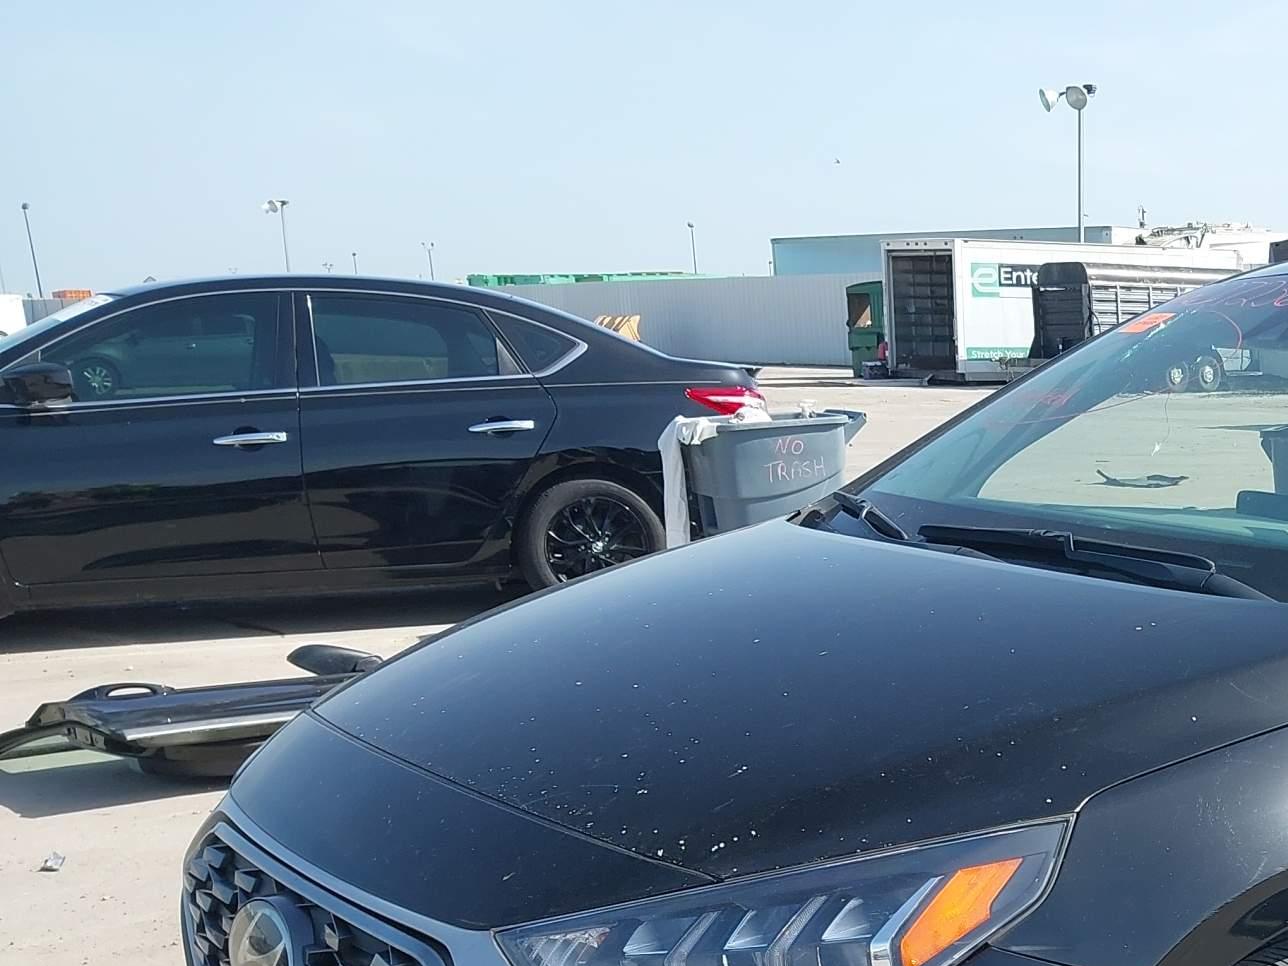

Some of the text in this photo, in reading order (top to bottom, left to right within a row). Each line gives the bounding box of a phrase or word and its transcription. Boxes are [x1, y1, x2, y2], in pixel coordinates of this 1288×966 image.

[971, 350, 1003, 359] Stretch
[1005, 350, 1025, 359] Your
[774, 437, 804, 455] NO
[762, 456, 827, 483] TRASH
